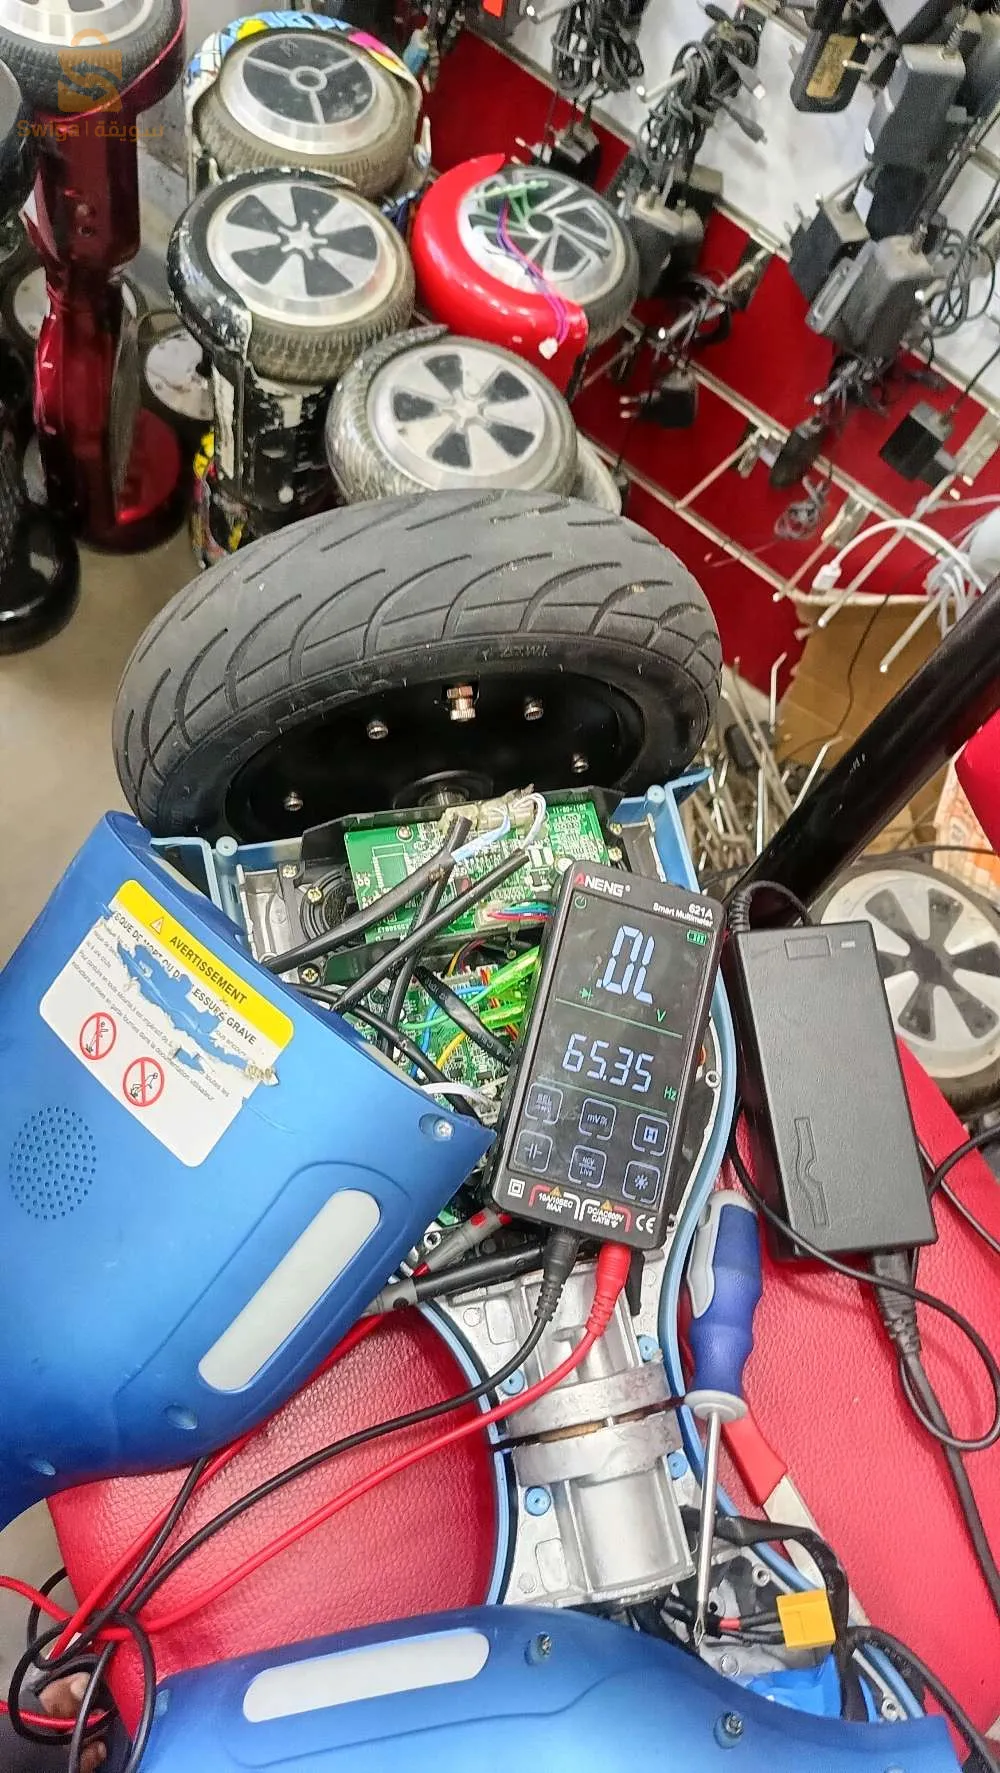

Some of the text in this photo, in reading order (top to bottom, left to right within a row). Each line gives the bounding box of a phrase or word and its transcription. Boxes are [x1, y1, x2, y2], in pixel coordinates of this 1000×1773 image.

[574, 871, 625, 898] ANENG
[651, 902, 713, 927] Smart Multimeter
[687, 903, 713, 920] 621A
[169, 934, 247, 1005] AVERTISSEMENT
[131, 929, 143, 941] DE
[225, 1015, 257, 1045] GRAVE
[654, 1008, 667, 1023] V
[560, 1031, 657, 1093] 65.35
[663, 1086, 678, 1100] Hz
[545, 1202, 562, 1213] MAX
[634, 1213, 656, 1233] CE
